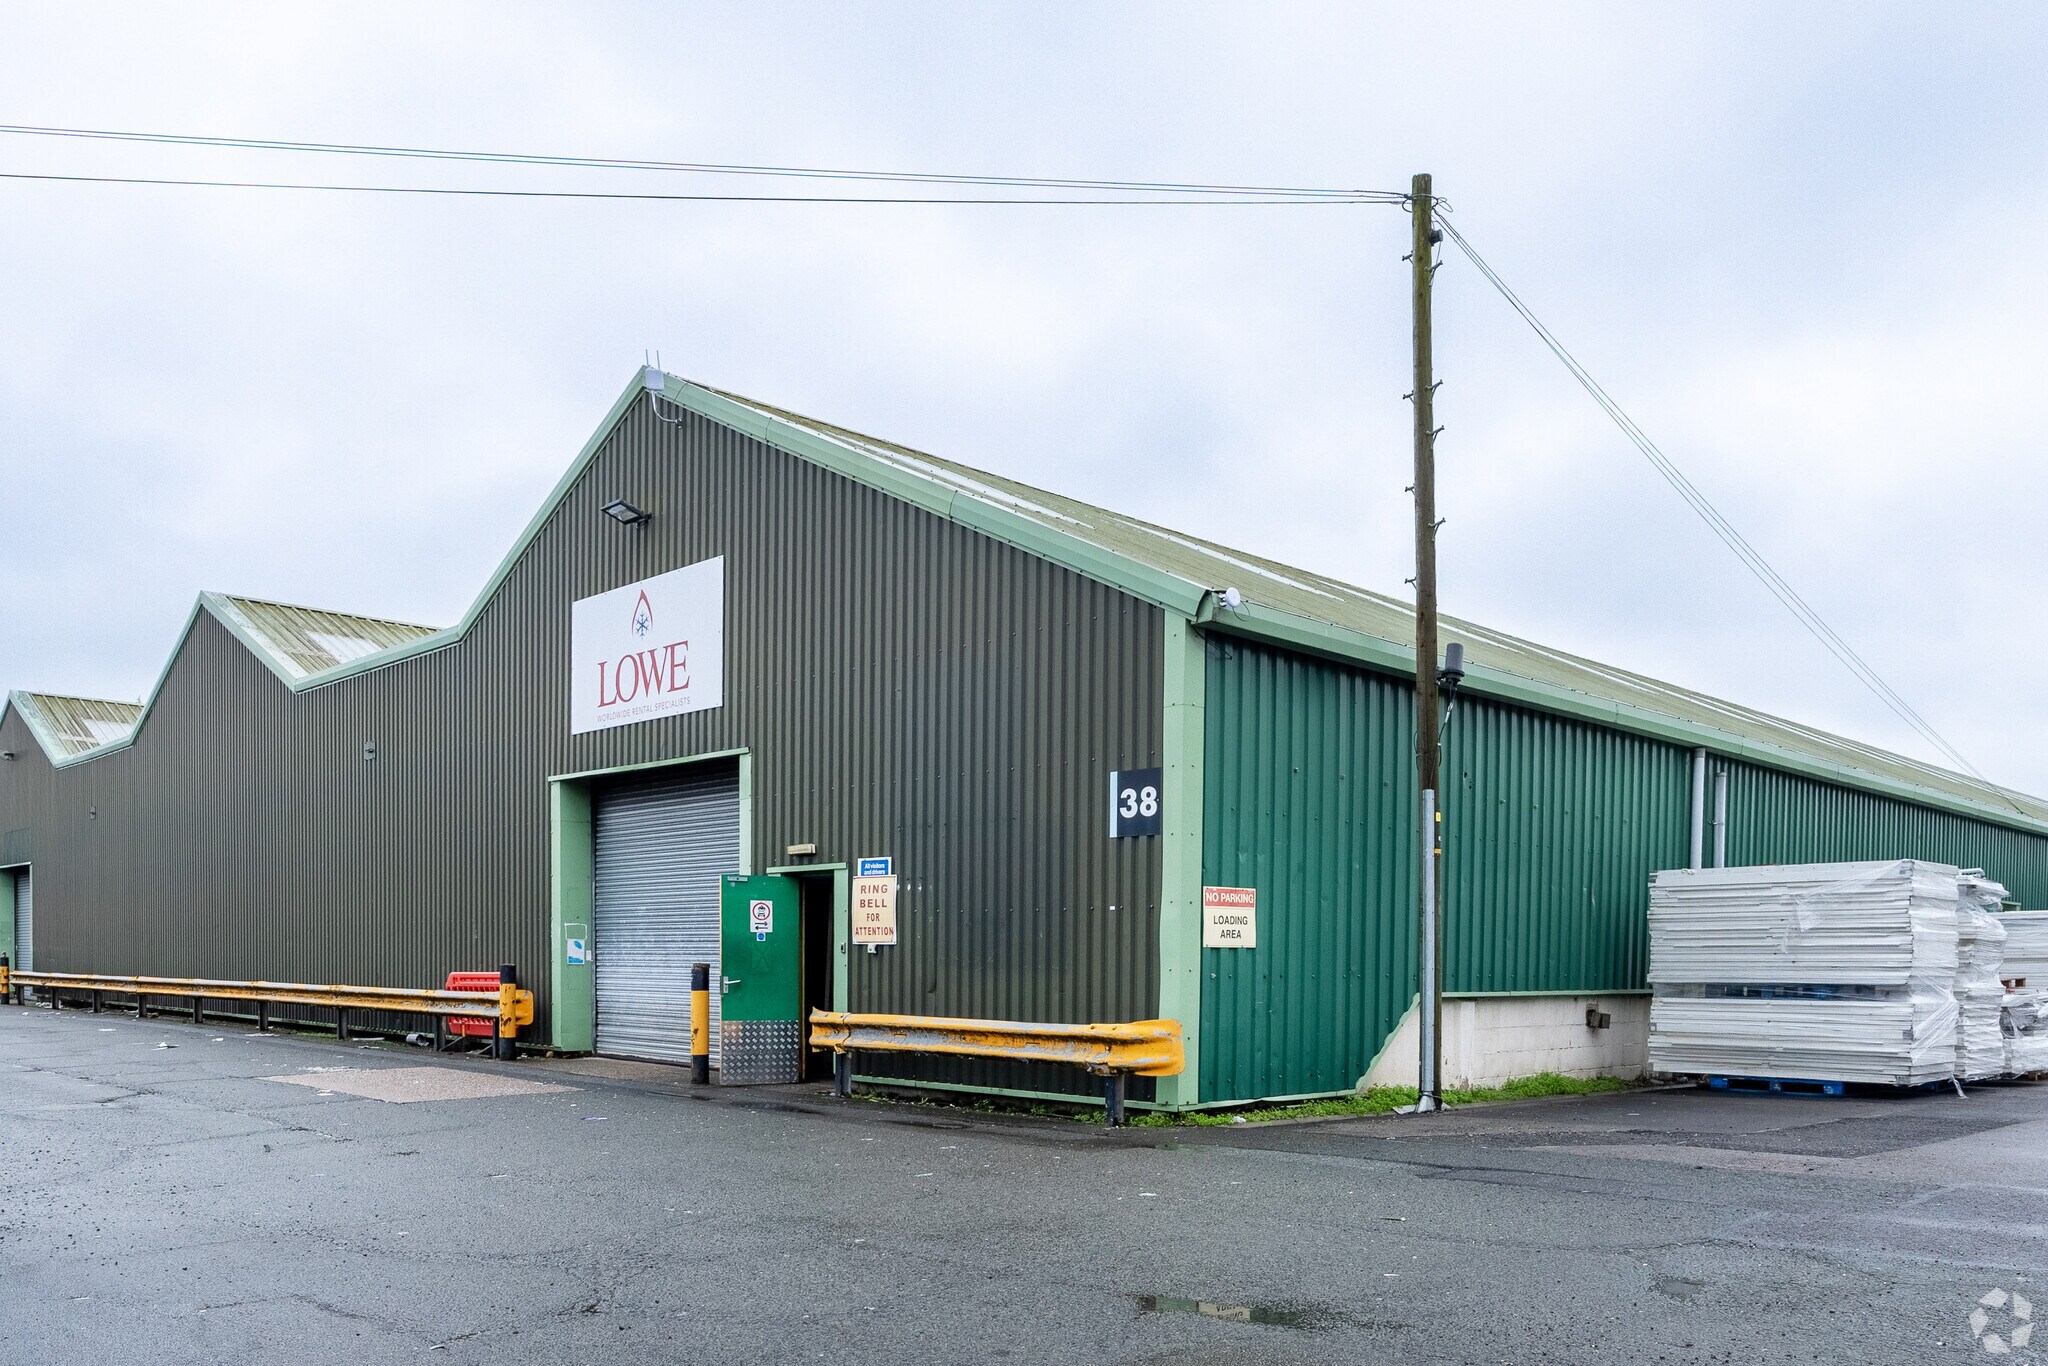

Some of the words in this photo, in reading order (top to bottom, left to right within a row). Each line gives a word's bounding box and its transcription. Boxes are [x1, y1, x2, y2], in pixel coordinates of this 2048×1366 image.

[597, 640, 690, 708] LOWE
[597, 709, 630, 722] WORLDWIDE
[632, 705, 653, 715] RENTAL
[655, 697, 690, 711] SPECIALISTS
[1119, 786, 1158, 819] 38
[860, 884, 888, 894] RING
[1206, 892, 1219, 902] NO
[1221, 893, 1253, 903] PARKING
[860, 899, 887, 908] BELL
[866, 913, 880, 922] FOR
[1213, 915, 1248, 925] LOADING
[855, 926, 894, 936] ATTENTION
[1220, 929, 1242, 939] AREA
